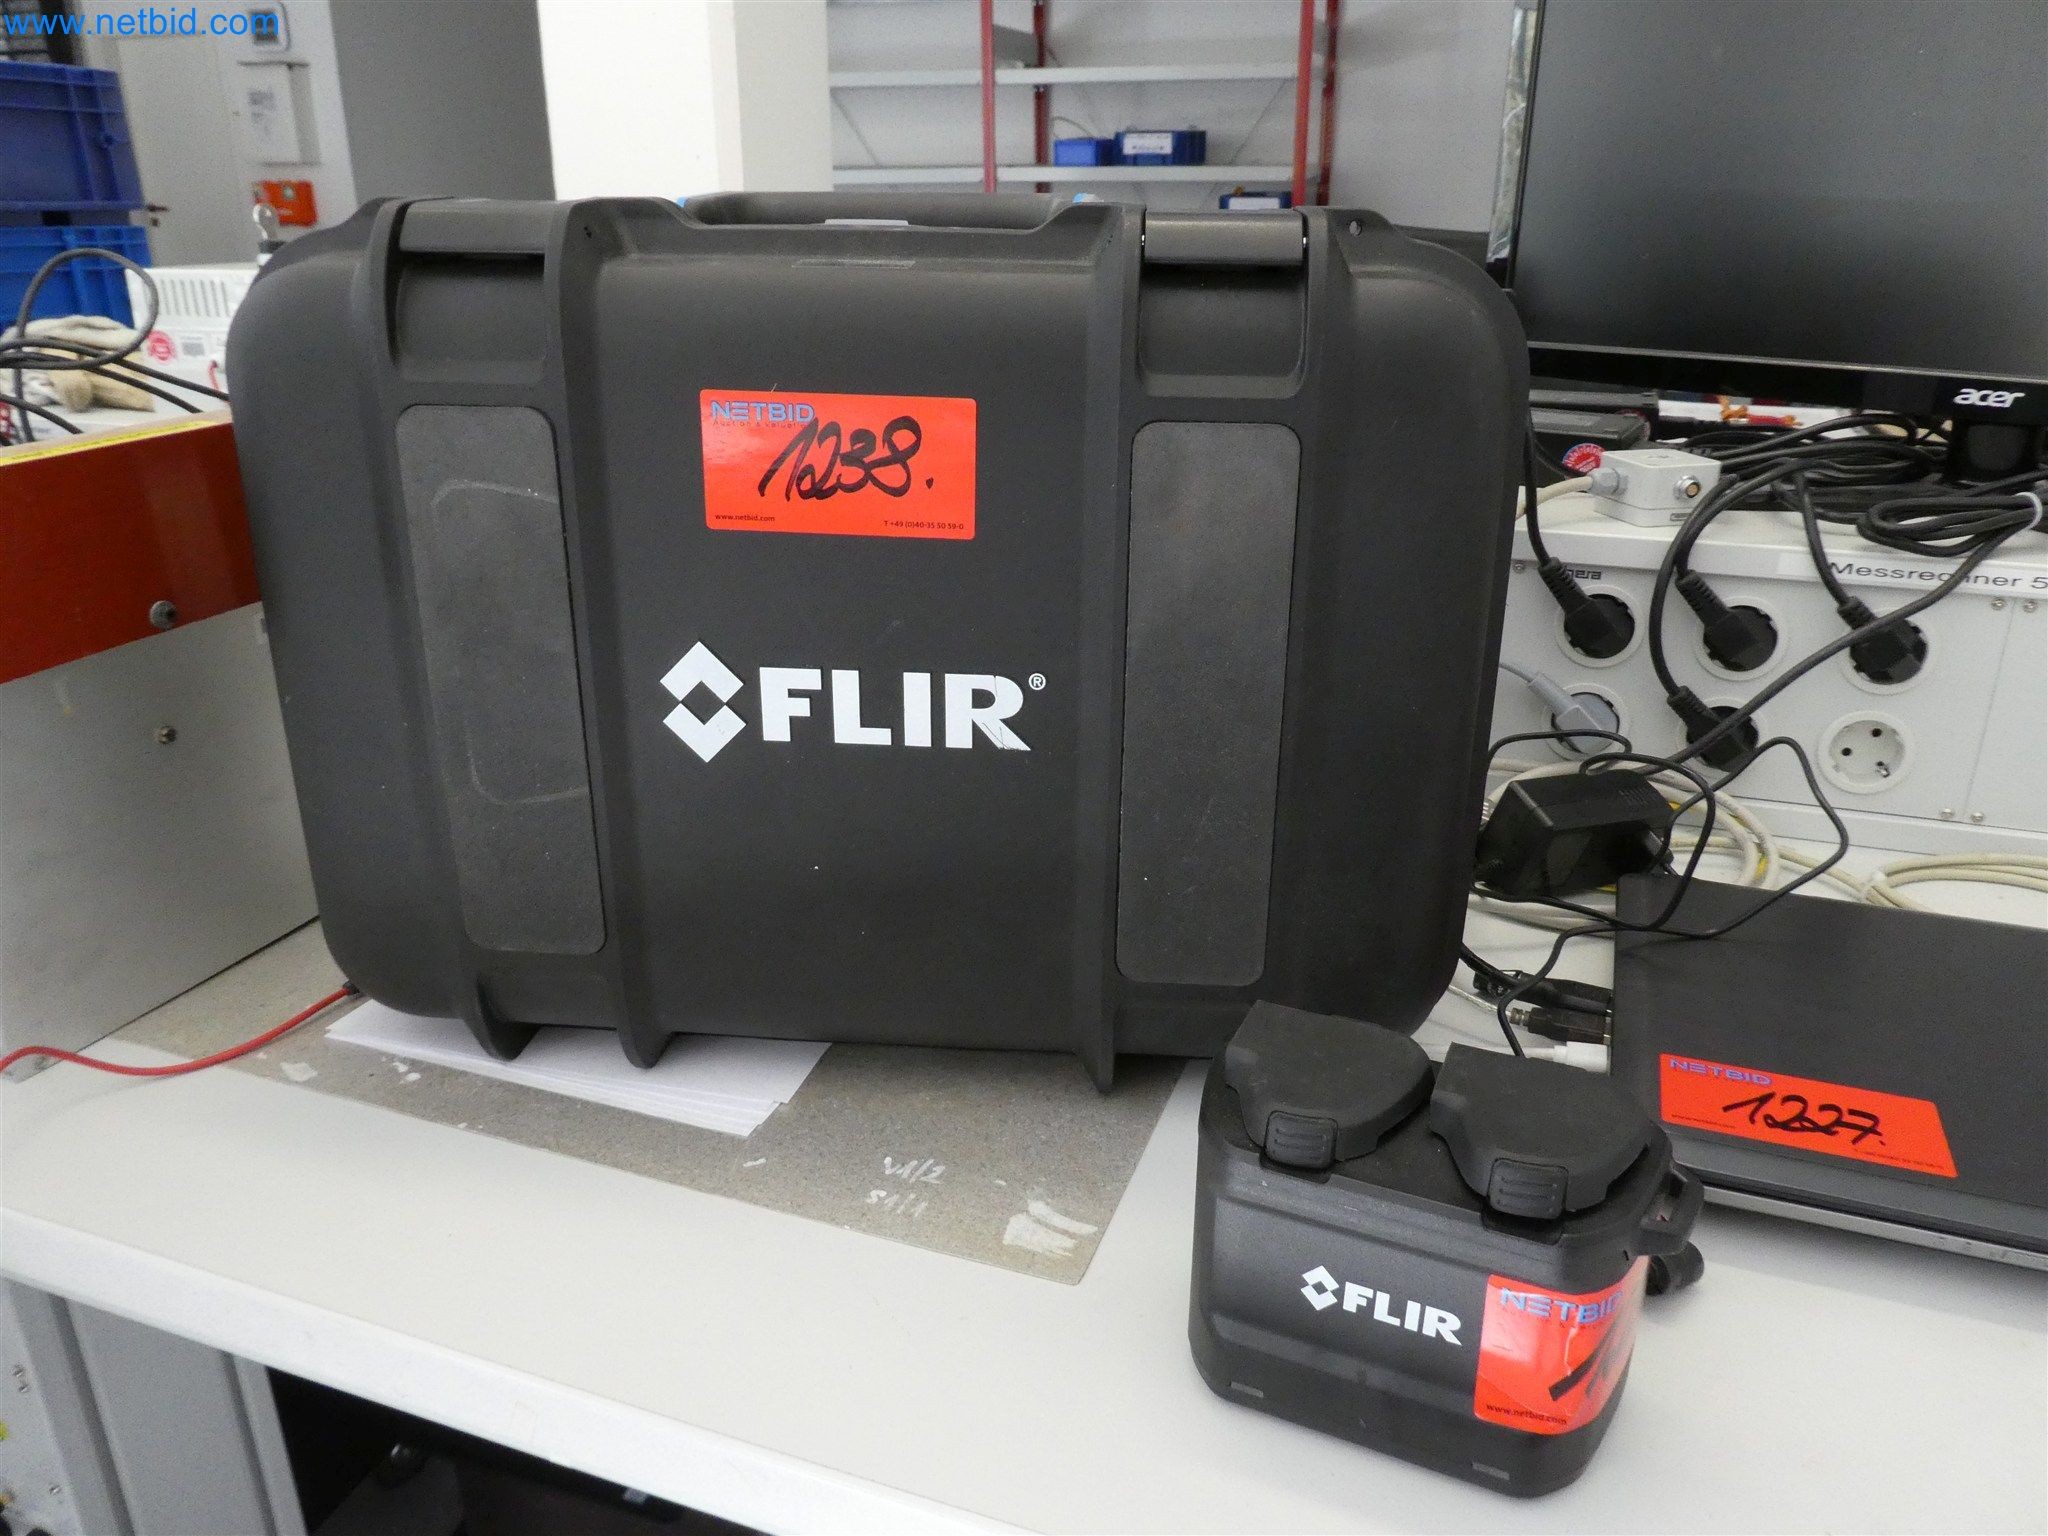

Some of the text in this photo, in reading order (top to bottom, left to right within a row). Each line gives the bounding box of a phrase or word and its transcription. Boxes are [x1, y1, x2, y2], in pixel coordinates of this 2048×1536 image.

[1953, 388, 2026, 408] acer
[711, 400, 815, 423] NETBID
[715, 513, 775, 522] www.netbid.com
[1830, 562, 2023, 588] Messrecner
[1669, 1059, 1772, 1086] NETBID
[1343, 1281, 1463, 1347] FLIR
[1486, 1403, 1567, 1426] www.netbid.com
